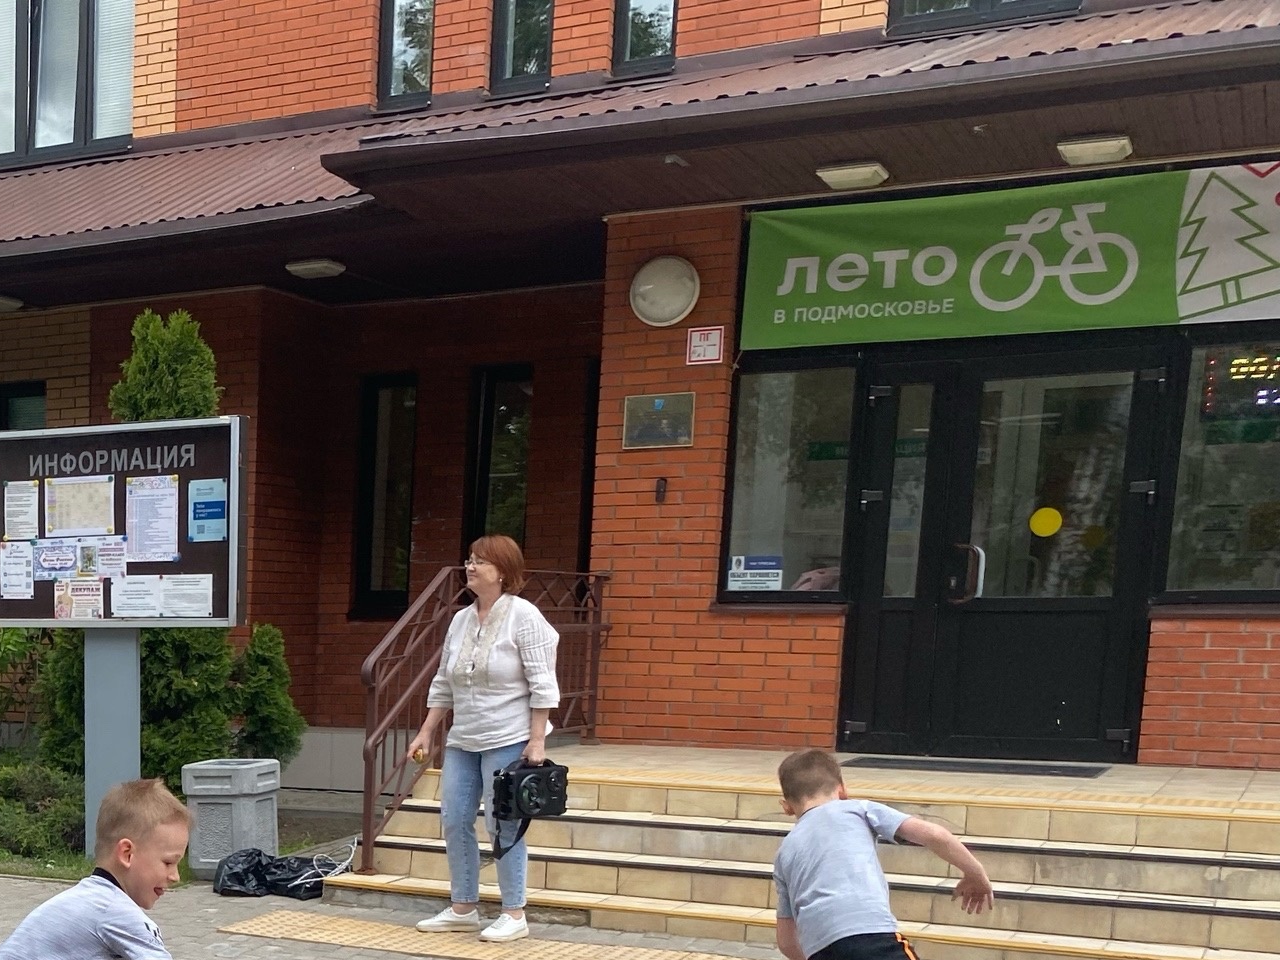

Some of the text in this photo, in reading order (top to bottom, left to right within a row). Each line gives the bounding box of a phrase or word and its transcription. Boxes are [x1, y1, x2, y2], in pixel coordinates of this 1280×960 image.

[773, 297, 955, 324] В ПОДМОСКОВЬЕ
[699, 332, 713, 342] ПГ
[29, 443, 196, 477] ИНФОРМАЦИЯ
